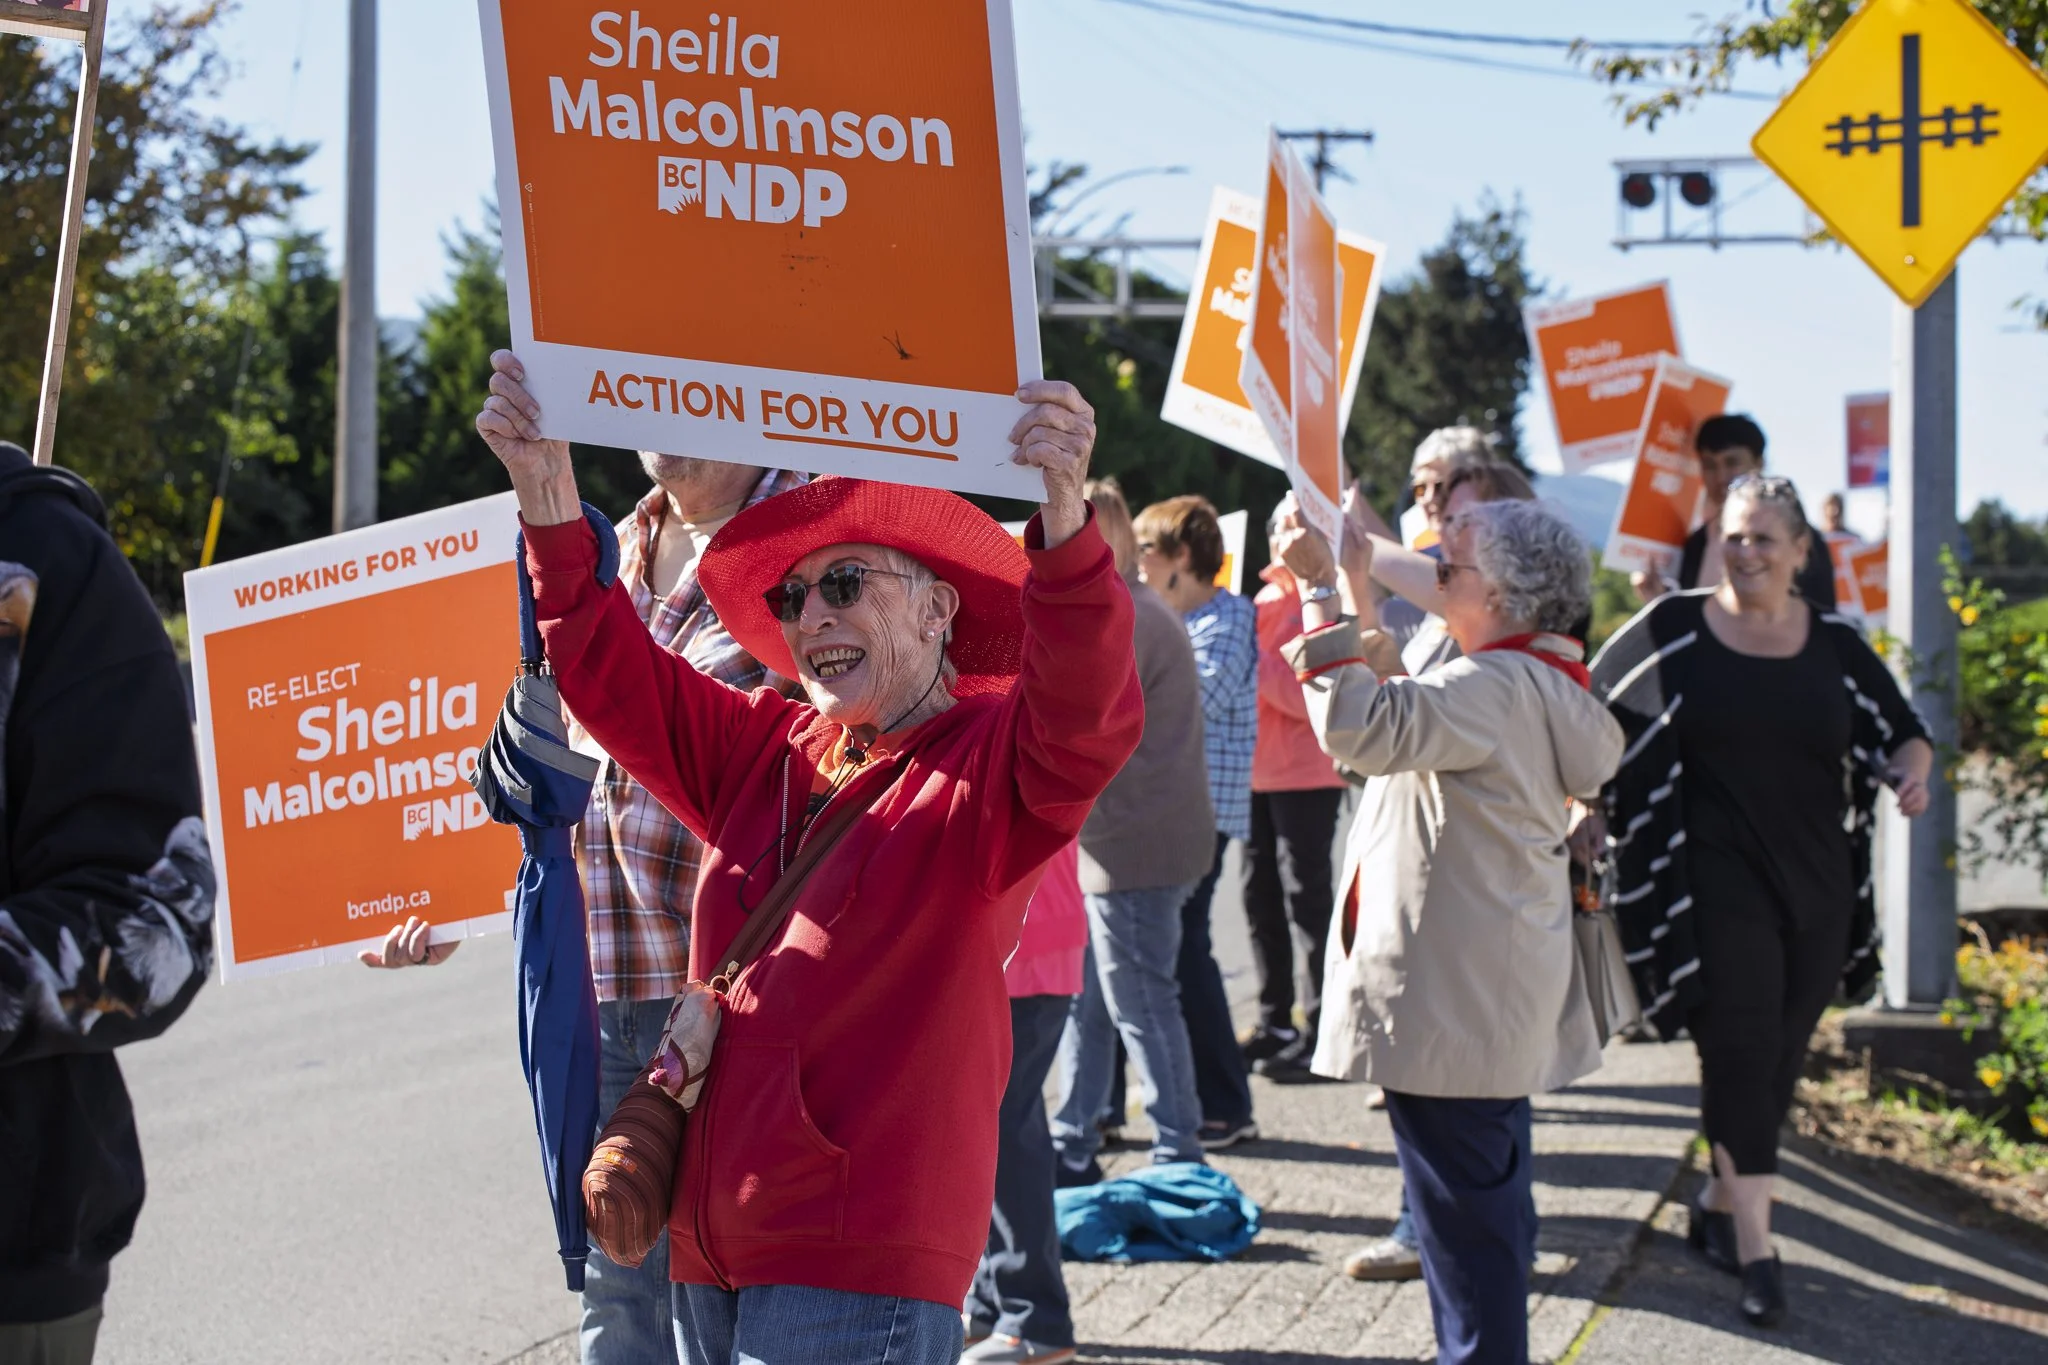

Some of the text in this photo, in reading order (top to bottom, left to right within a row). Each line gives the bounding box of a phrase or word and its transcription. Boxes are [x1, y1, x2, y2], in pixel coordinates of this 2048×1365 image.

[588, 11, 780, 79] Sheila
[548, 75, 954, 167] Malcolmson
[664, 159, 848, 228] BC NDP
[588, 370, 959, 448] ACTION FOR YOU
[234, 529, 480, 609] WORKING FOR YOU
[247, 662, 361, 710] RE-ELECT
[296, 676, 478, 762] Sheila
[243, 746, 480, 829] Malcolmso
[407, 790, 497, 837] BC ND
[346, 890, 431, 926] bcndp.ca
